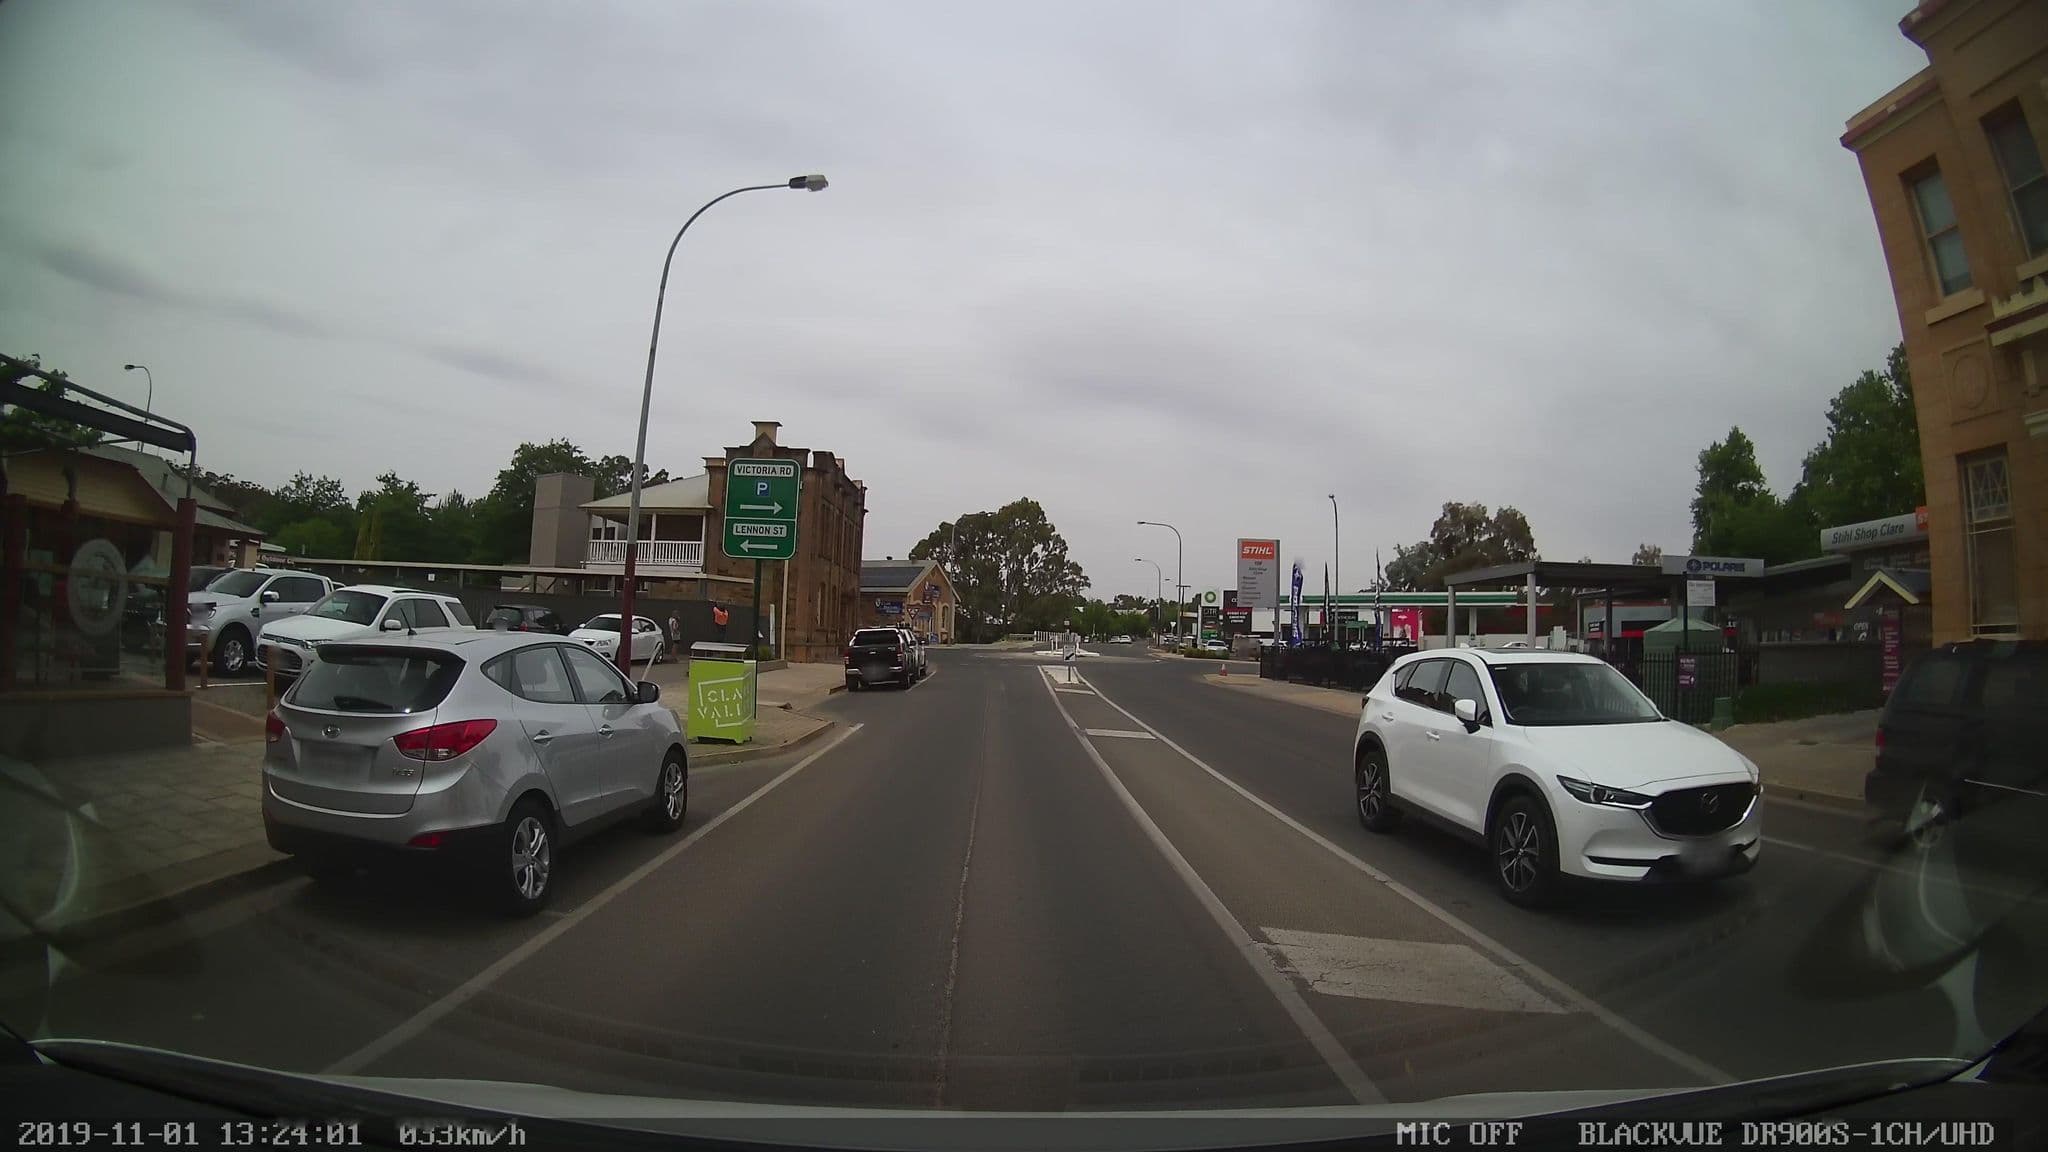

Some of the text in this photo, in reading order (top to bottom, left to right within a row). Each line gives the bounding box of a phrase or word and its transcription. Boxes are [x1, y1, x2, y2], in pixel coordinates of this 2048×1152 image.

[736, 465, 792, 475] VICTORIA RD
[756, 482, 768, 496] P
[735, 525, 785, 535] LENNON ST
[1831, 523, 1905, 545] Stihl Shop Clare
[1242, 546, 1273, 555] STIHL
[1702, 561, 1746, 572] POLARIS
